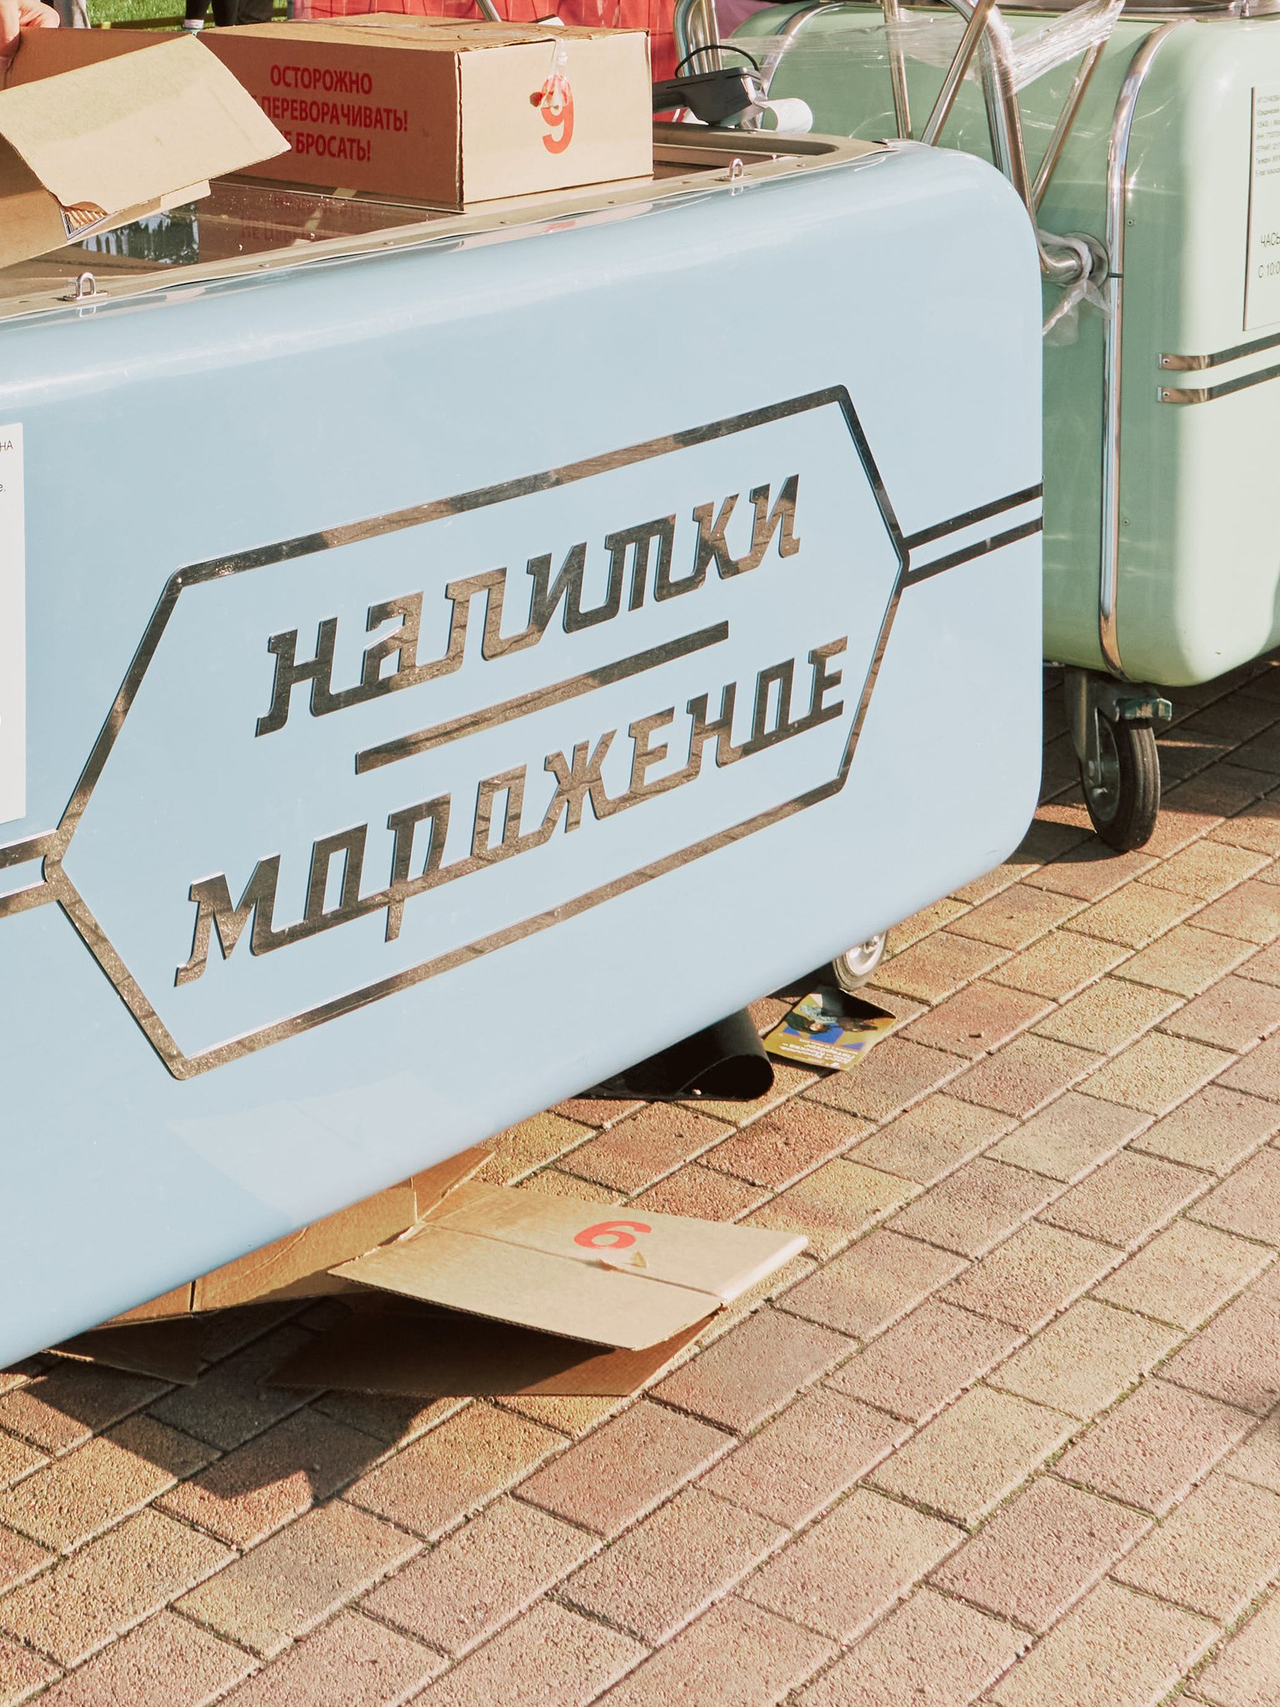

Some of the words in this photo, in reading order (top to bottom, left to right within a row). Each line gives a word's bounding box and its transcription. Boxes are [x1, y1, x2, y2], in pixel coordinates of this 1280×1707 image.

[270, 64, 373, 94] ОСТОРОЖНО
[261, 94, 408, 132] ПЕРЕВОРАЧИВАТЬ!
[541, 74, 574, 154] 9
[295, 131, 371, 162] БРОСАТЬ!
